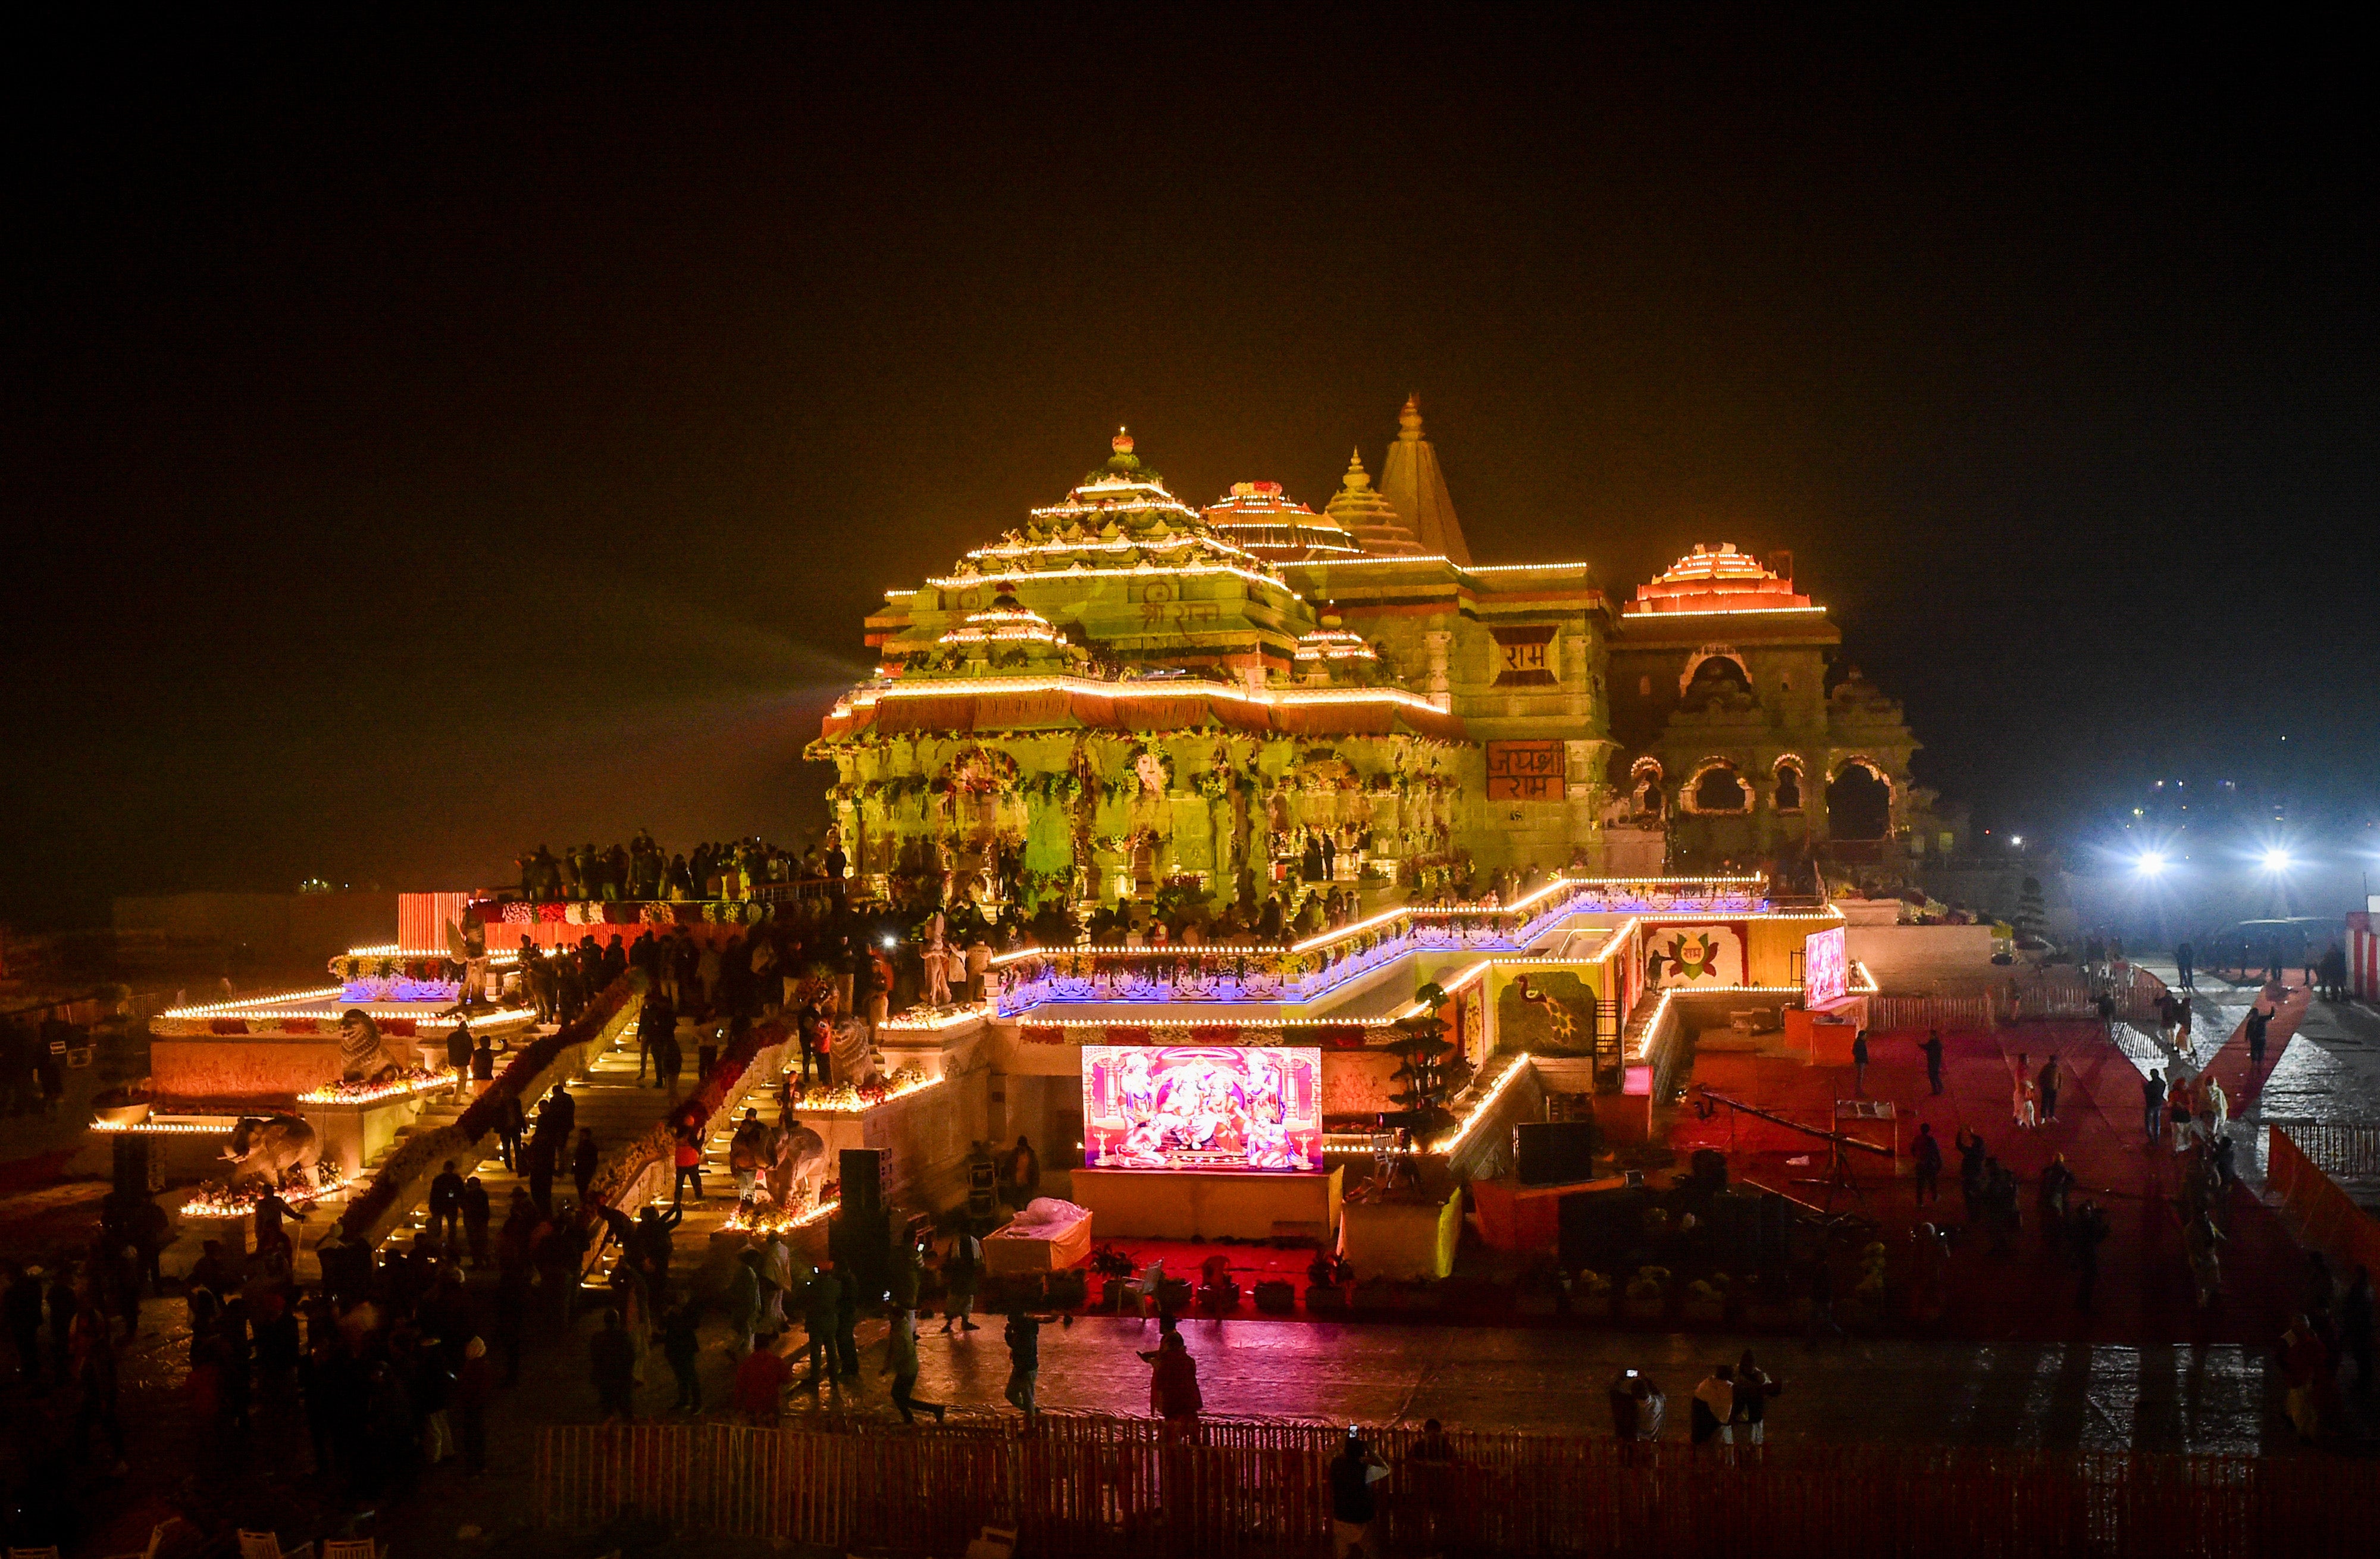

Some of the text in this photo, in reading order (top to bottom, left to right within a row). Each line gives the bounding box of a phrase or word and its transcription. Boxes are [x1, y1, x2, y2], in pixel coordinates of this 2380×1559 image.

[1506, 644, 1545, 669] राम
[1509, 775, 1547, 798] राम
[1683, 948, 1702, 959] राम
